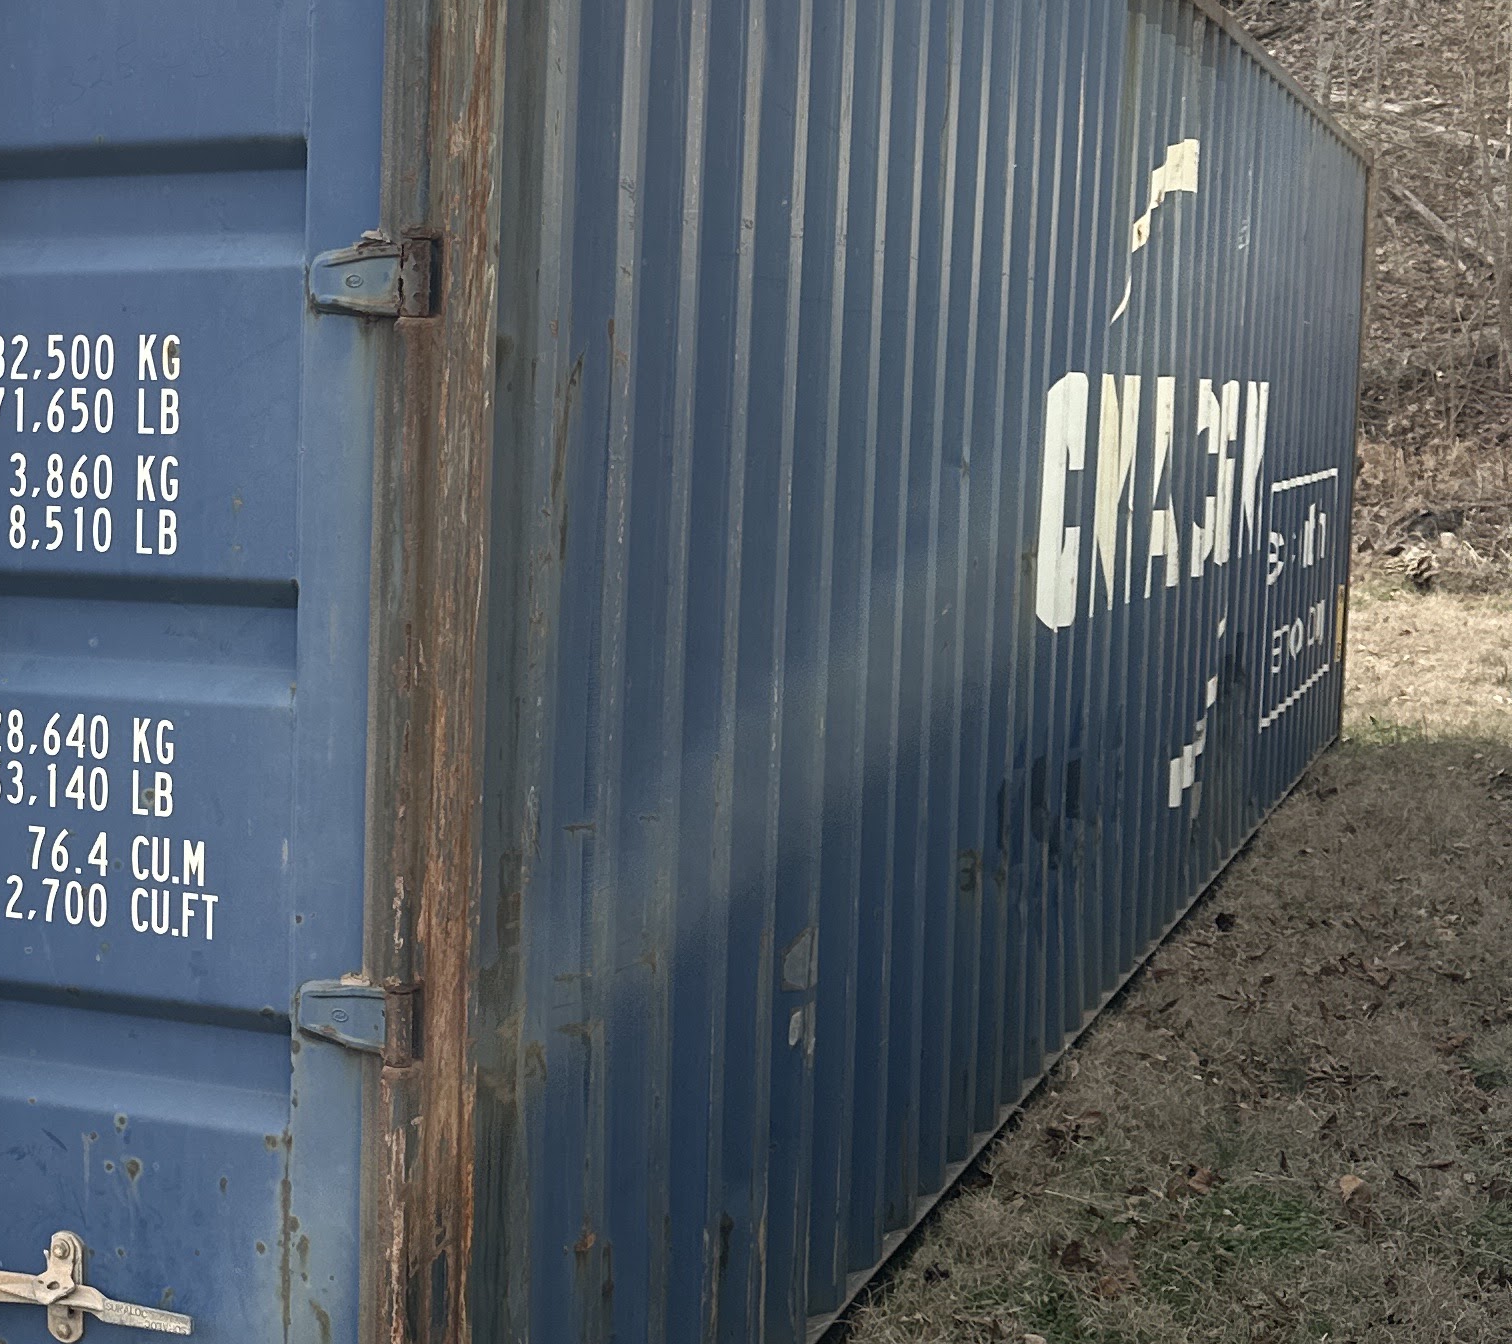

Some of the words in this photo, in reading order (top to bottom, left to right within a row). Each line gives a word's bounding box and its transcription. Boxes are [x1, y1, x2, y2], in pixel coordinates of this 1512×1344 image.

[138, 334, 181, 381] KG
[137, 387, 180, 435] LB
[9, 452, 113, 500] 3,860
[136, 454, 179, 502] KG
[8, 505, 112, 553] 8,510
[136, 508, 178, 556] LB
[132, 717, 174, 765] KG
[132, 769, 173, 818] LB
[28, 825, 109, 876] 76.4
[131, 835, 205, 887] CU.M
[5, 874, 107, 928] 2,700
[131, 887, 219, 941] CU.FT
